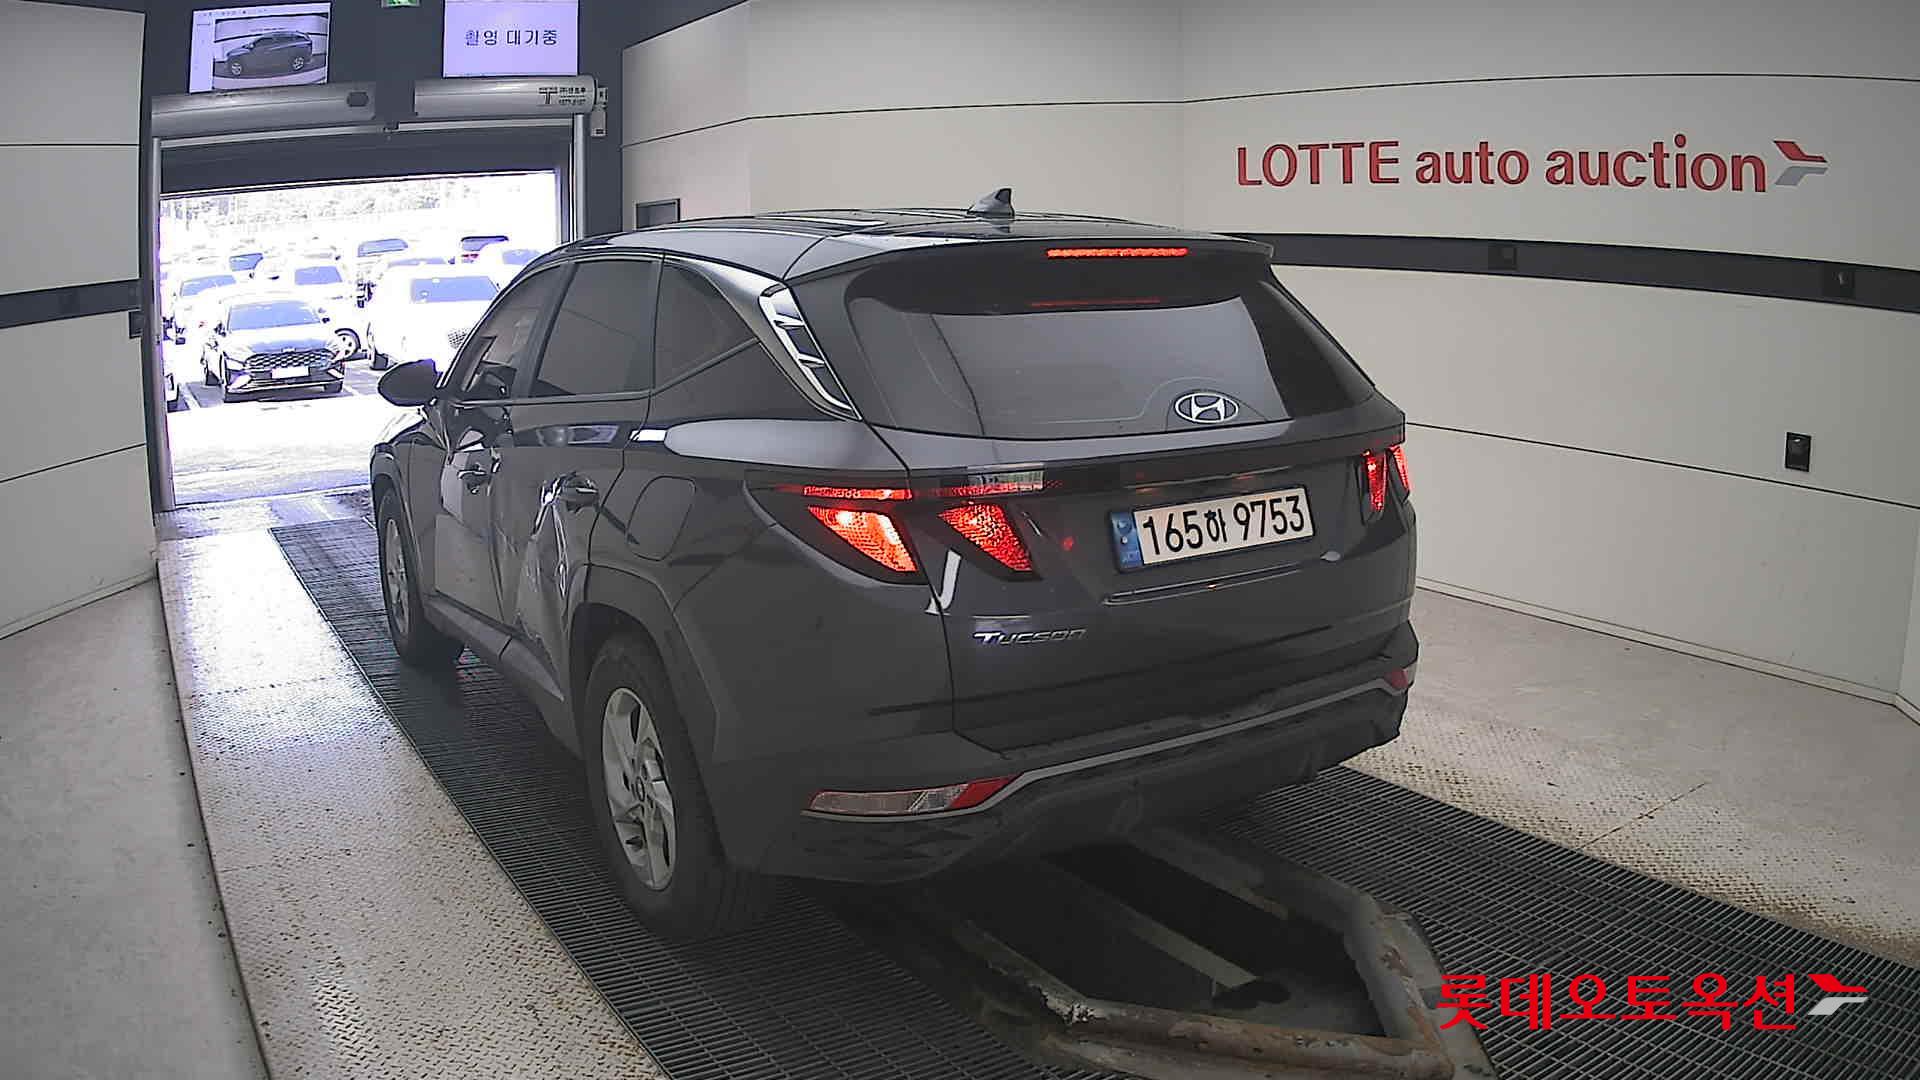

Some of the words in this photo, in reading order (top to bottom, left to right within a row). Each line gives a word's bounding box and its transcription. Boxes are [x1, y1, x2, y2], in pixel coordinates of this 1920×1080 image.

[506, 30, 557, 46] 대기중
[1237, 141, 1400, 187] LOTTE
[1415, 141, 1530, 185] auto
[1545, 134, 1767, 192] auction
[1143, 508, 1228, 555] 165하
[1233, 496, 1305, 541] 9753
